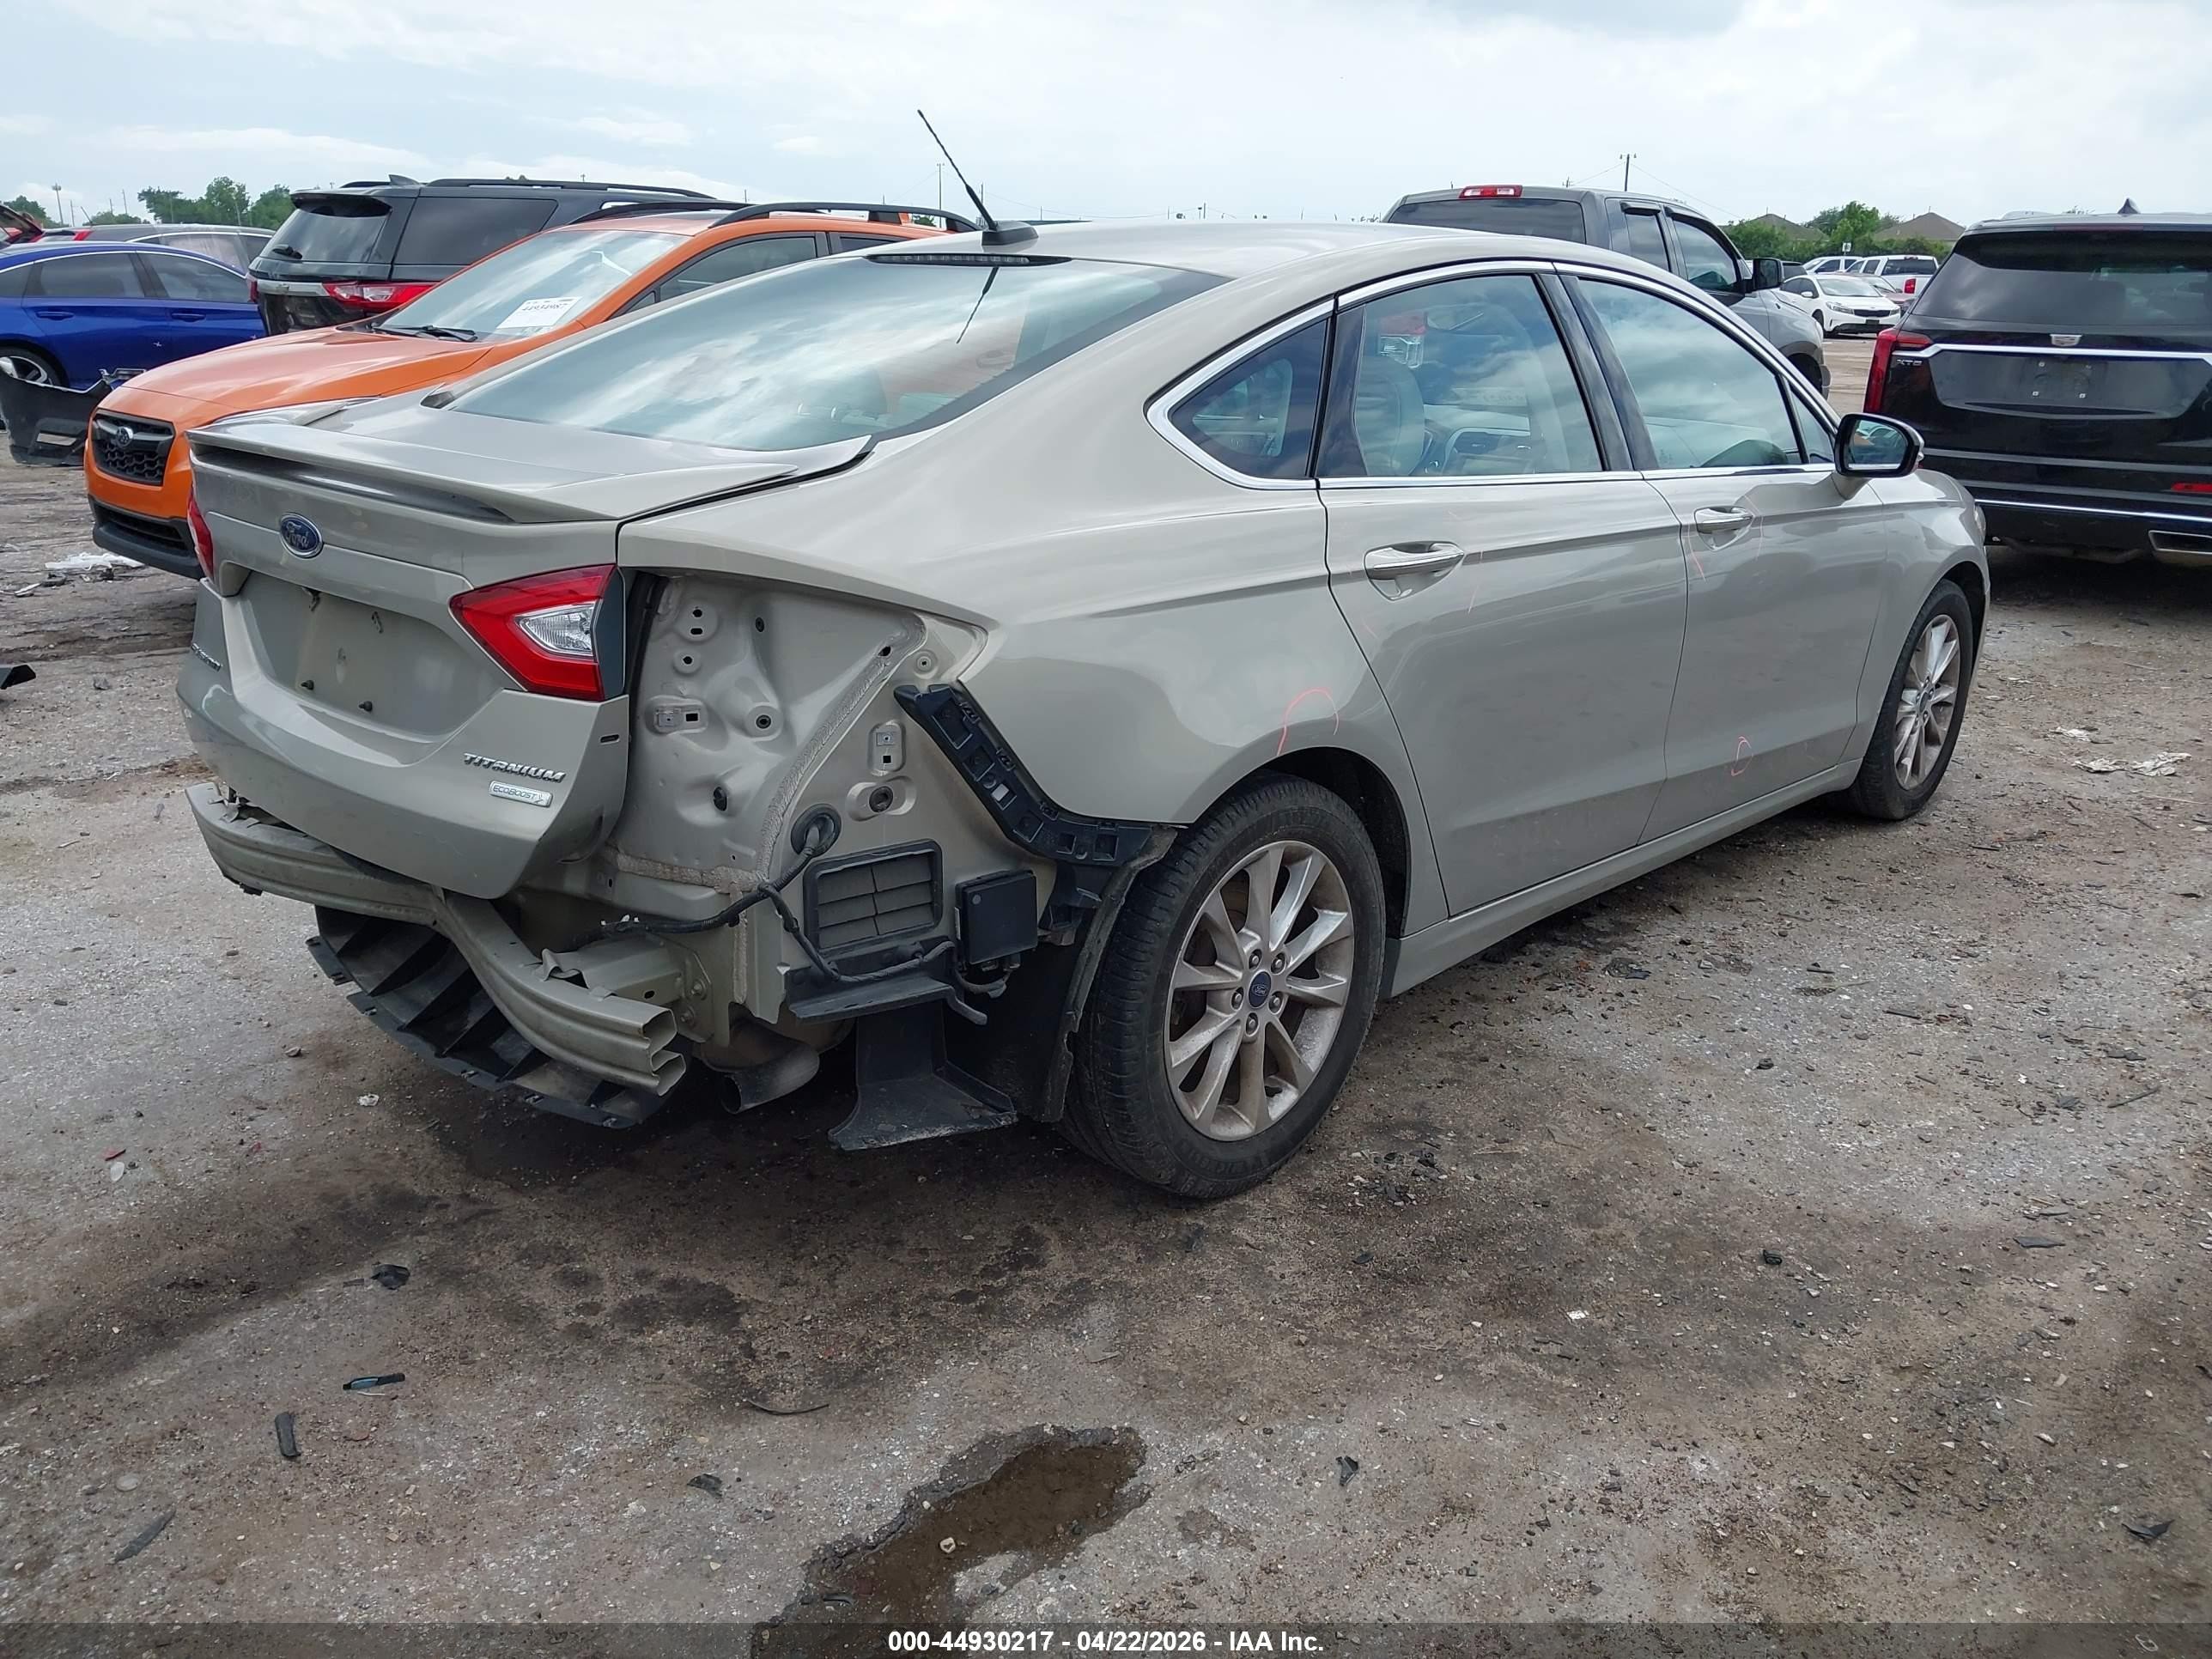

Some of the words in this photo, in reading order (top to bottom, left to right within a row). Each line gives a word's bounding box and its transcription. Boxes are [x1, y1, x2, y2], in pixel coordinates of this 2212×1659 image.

[285, 520, 310, 549] Ford
[464, 752, 567, 783] TITANIUM
[492, 785, 537, 799] ECOBOOST
